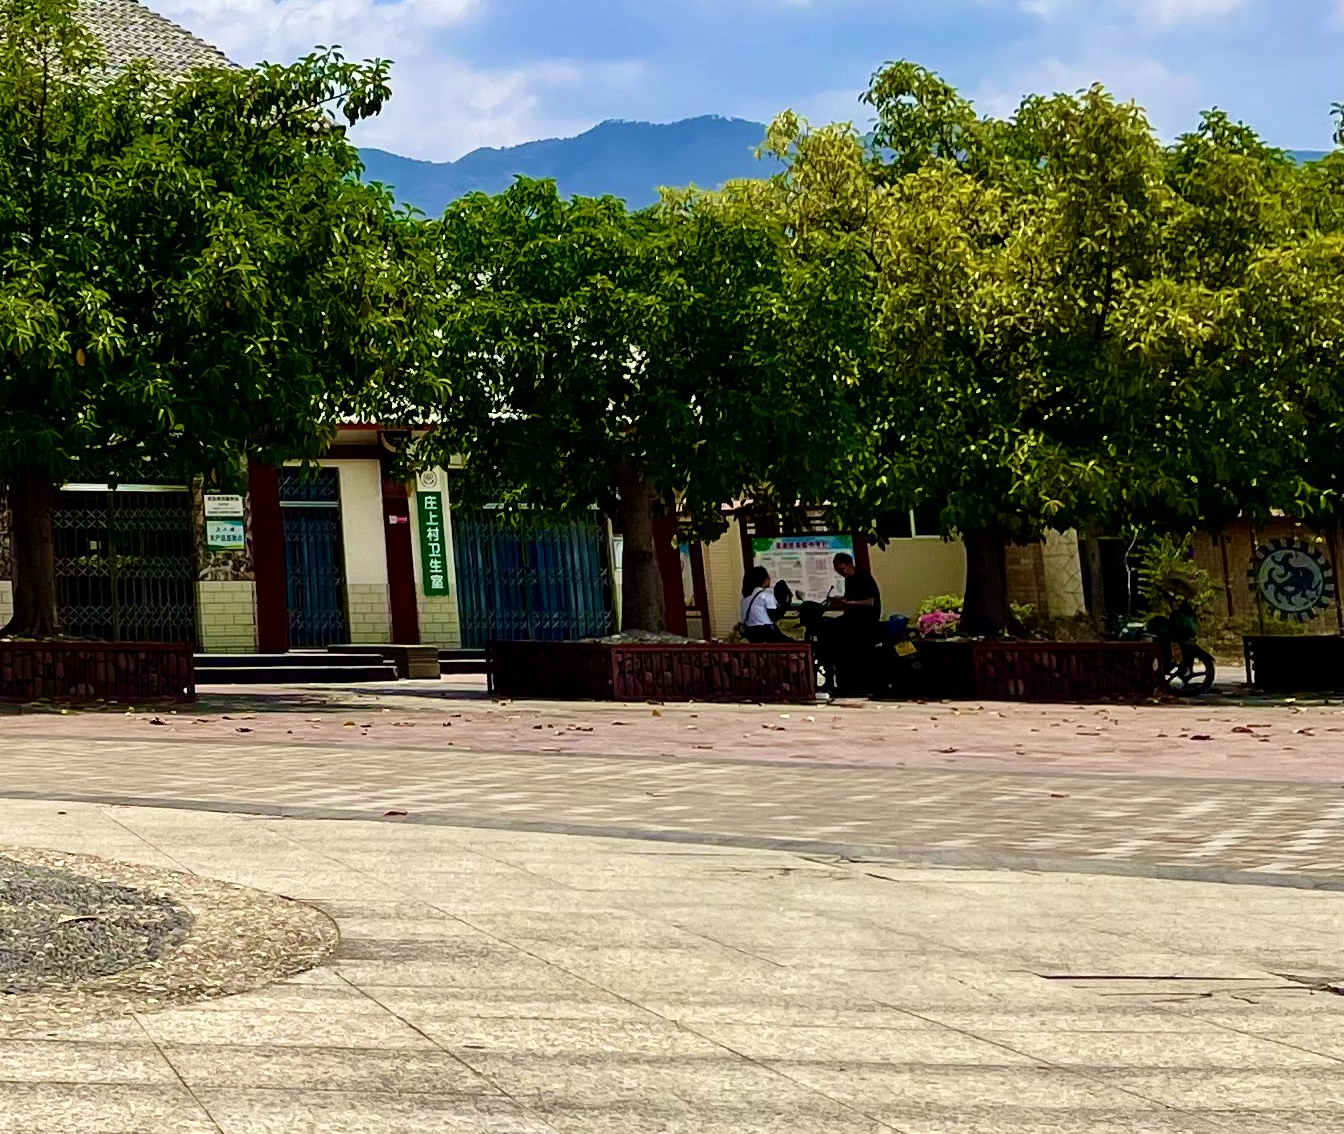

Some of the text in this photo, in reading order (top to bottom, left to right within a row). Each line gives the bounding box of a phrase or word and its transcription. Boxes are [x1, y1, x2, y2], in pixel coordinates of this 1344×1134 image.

[424, 495, 445, 590] 庄上村卫生室
